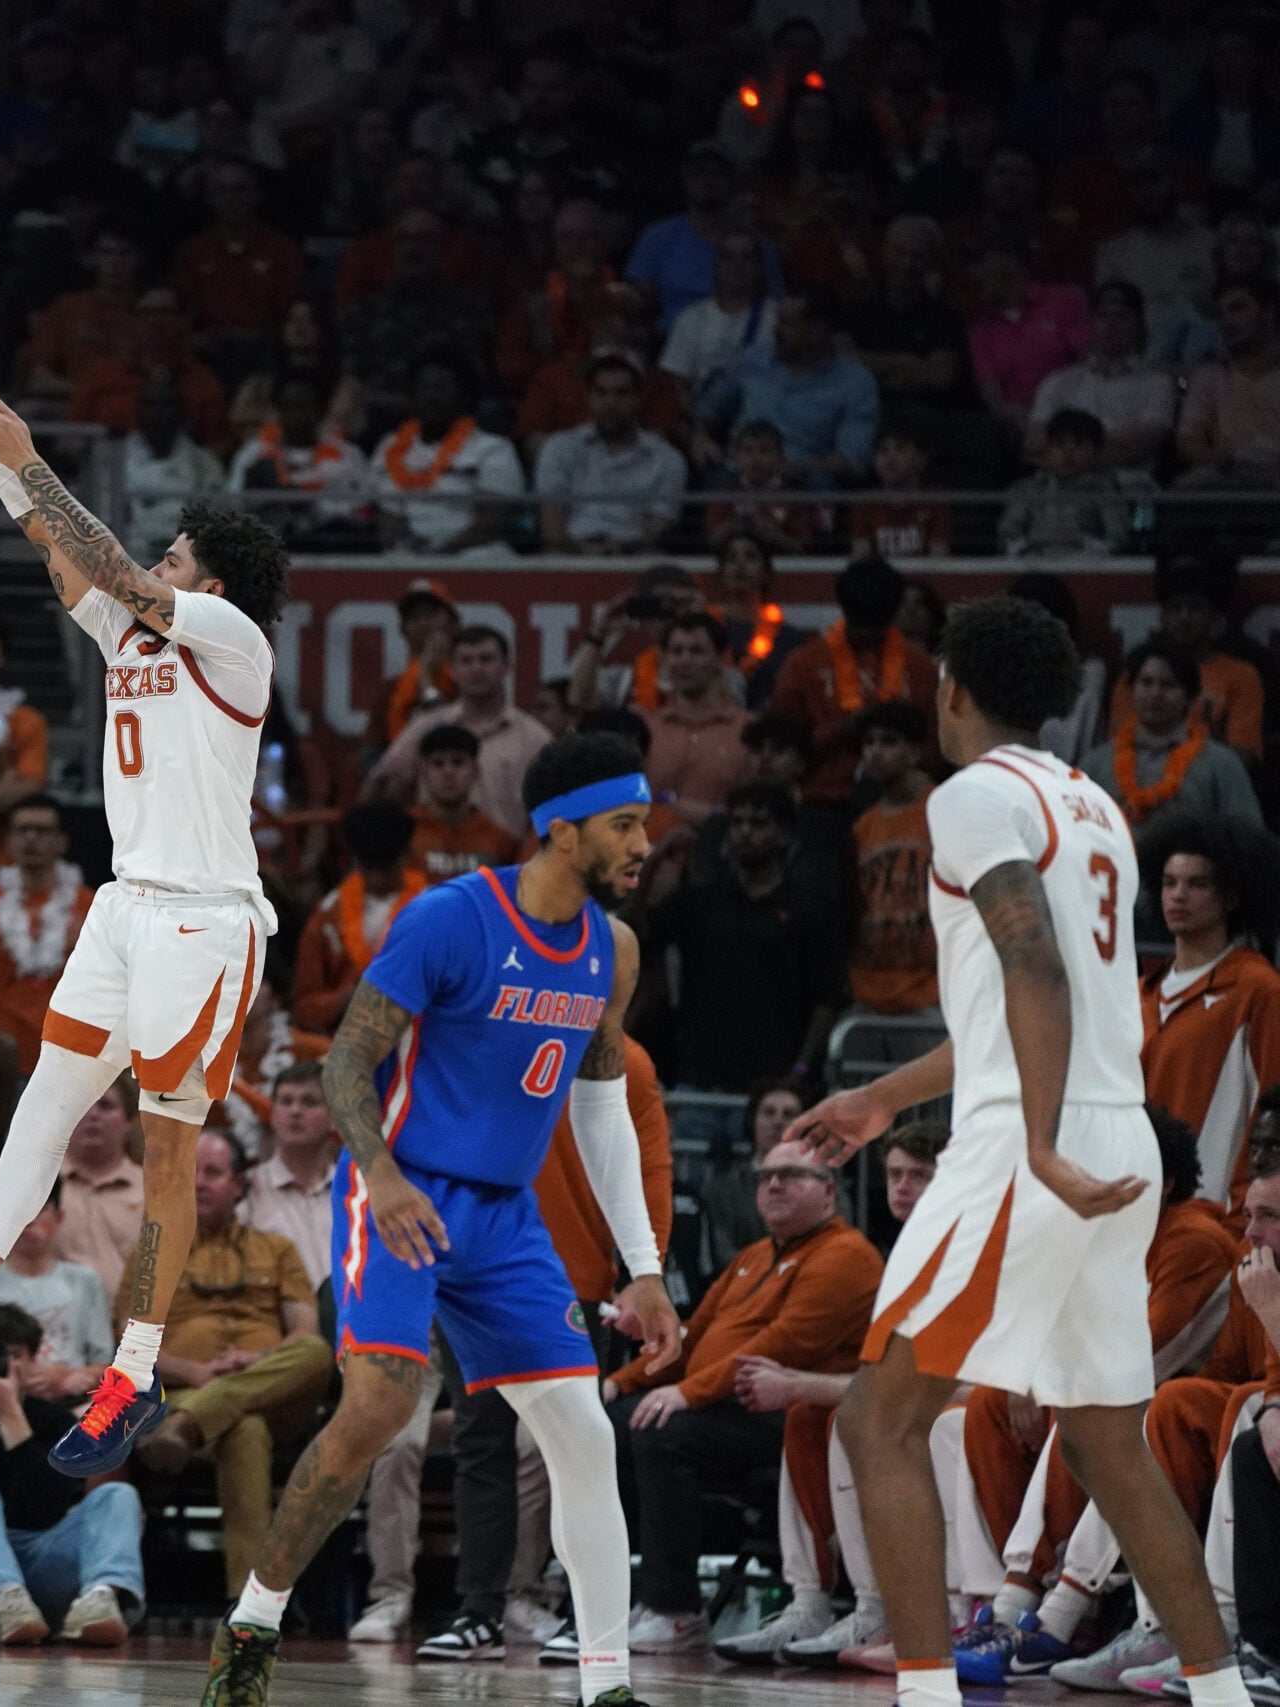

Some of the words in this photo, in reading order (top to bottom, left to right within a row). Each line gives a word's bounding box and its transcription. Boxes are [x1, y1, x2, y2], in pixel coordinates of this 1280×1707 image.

[106, 662, 178, 700] EXAS
[114, 710, 144, 778] 0
[1089, 852, 1118, 966] 3
[520, 1037, 567, 1099] 0
